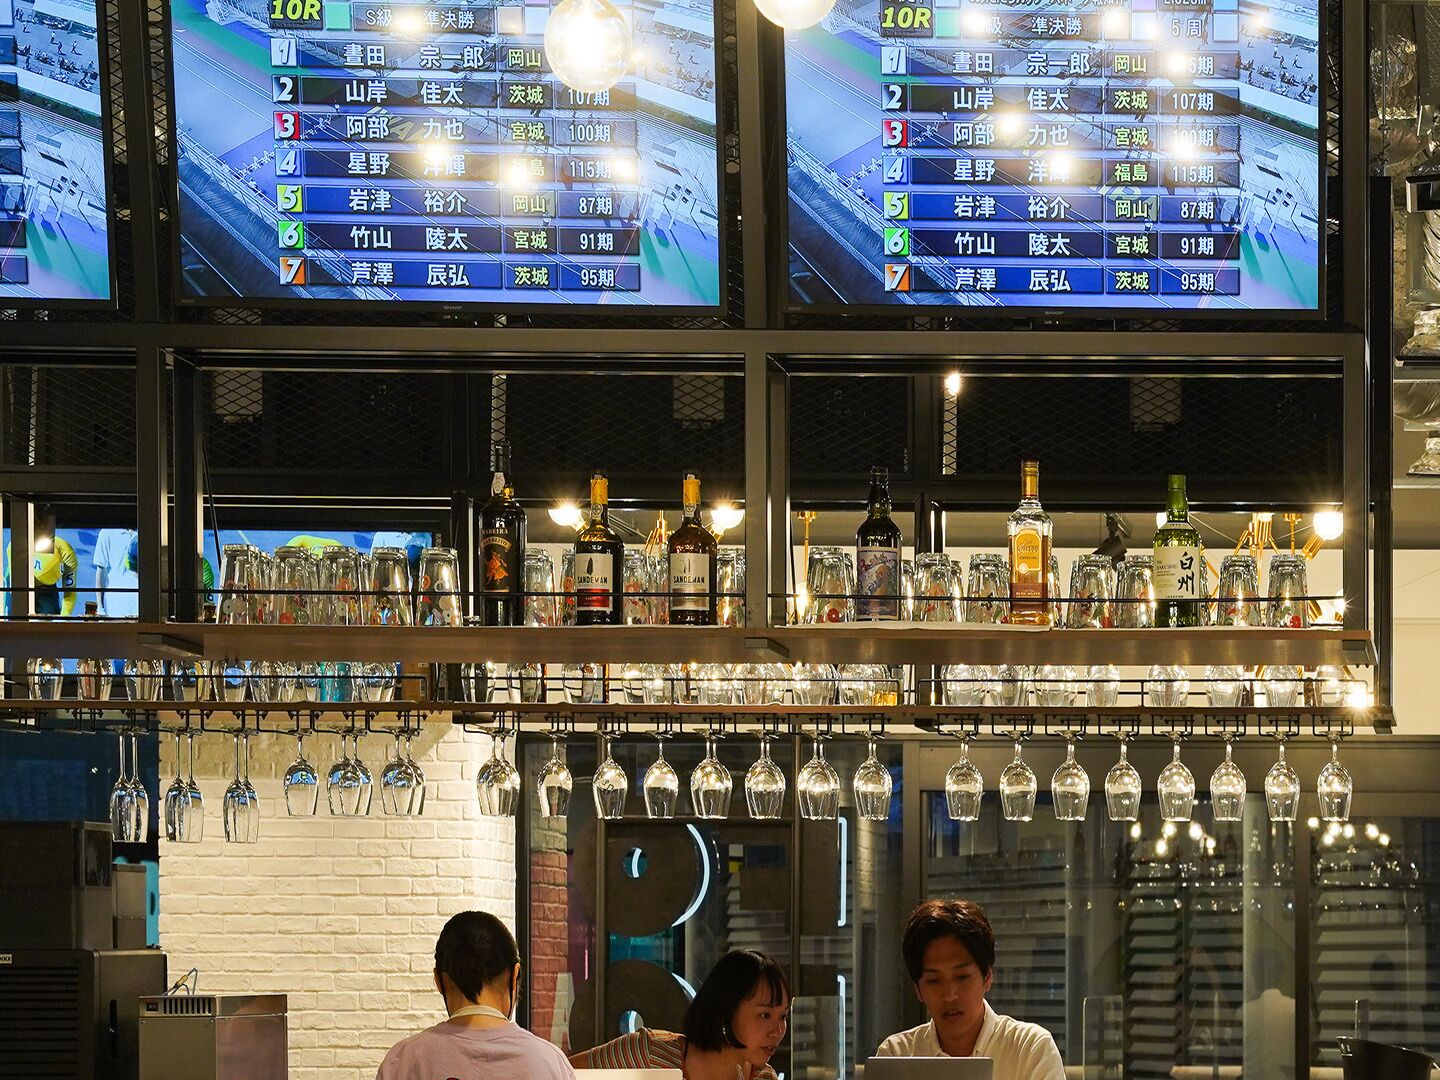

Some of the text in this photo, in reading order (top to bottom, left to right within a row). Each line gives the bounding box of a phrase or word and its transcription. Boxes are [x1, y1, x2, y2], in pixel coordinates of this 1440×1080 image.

[270, 0, 321, 20] 10R
[424, 10, 475, 29] 準決勝
[882, 7, 931, 29] 10R
[1032, 17, 1082, 36] 準決勝
[279, 40, 291, 65] 1
[419, 45, 484, 69] 宗一郎
[508, 49, 542, 67] 岡山
[889, 48, 900, 72] 1
[1027, 52, 1090, 76] 宗一郎
[1114, 55, 1147, 73] 岡山
[279, 77, 294, 102] 2
[345, 80, 388, 103] 山岸
[420, 81, 464, 105] 佳太
[509, 85, 544, 104] 茨城
[885, 85, 1213, 111] 2 山岸 佳太 茨城 107期
[280, 113, 611, 142] 3 阿部 力也 宮城 100期
[886, 122, 903, 146] 3
[953, 123, 995, 146] 阿部
[1028, 125, 1069, 146] 力也
[1115, 127, 1148, 145] 宮城
[279, 151, 296, 175] 4
[348, 152, 390, 176] 星野
[570, 160, 612, 178] 115期
[887, 157, 904, 181] 4
[953, 159, 995, 182] 星野
[1114, 163, 1148, 182] 福島
[1172, 165, 1213, 183] 115期
[283, 186, 613, 215] 5 岩津 裕介 岡山 87期
[888, 194, 1213, 219] 5 岩津 裕介 岡山 87期
[283, 223, 613, 250] 6 竹山 陵太 宮城 91期
[888, 230, 1214, 256] 6 竹山 陵太 宮城 91期
[285, 259, 614, 287] 7 芦澤 辰弘 茨城 95期
[891, 265, 1214, 292] 7 芦澤 辰弘 茨城 95期
[1178, 551, 1195, 595] 白州
